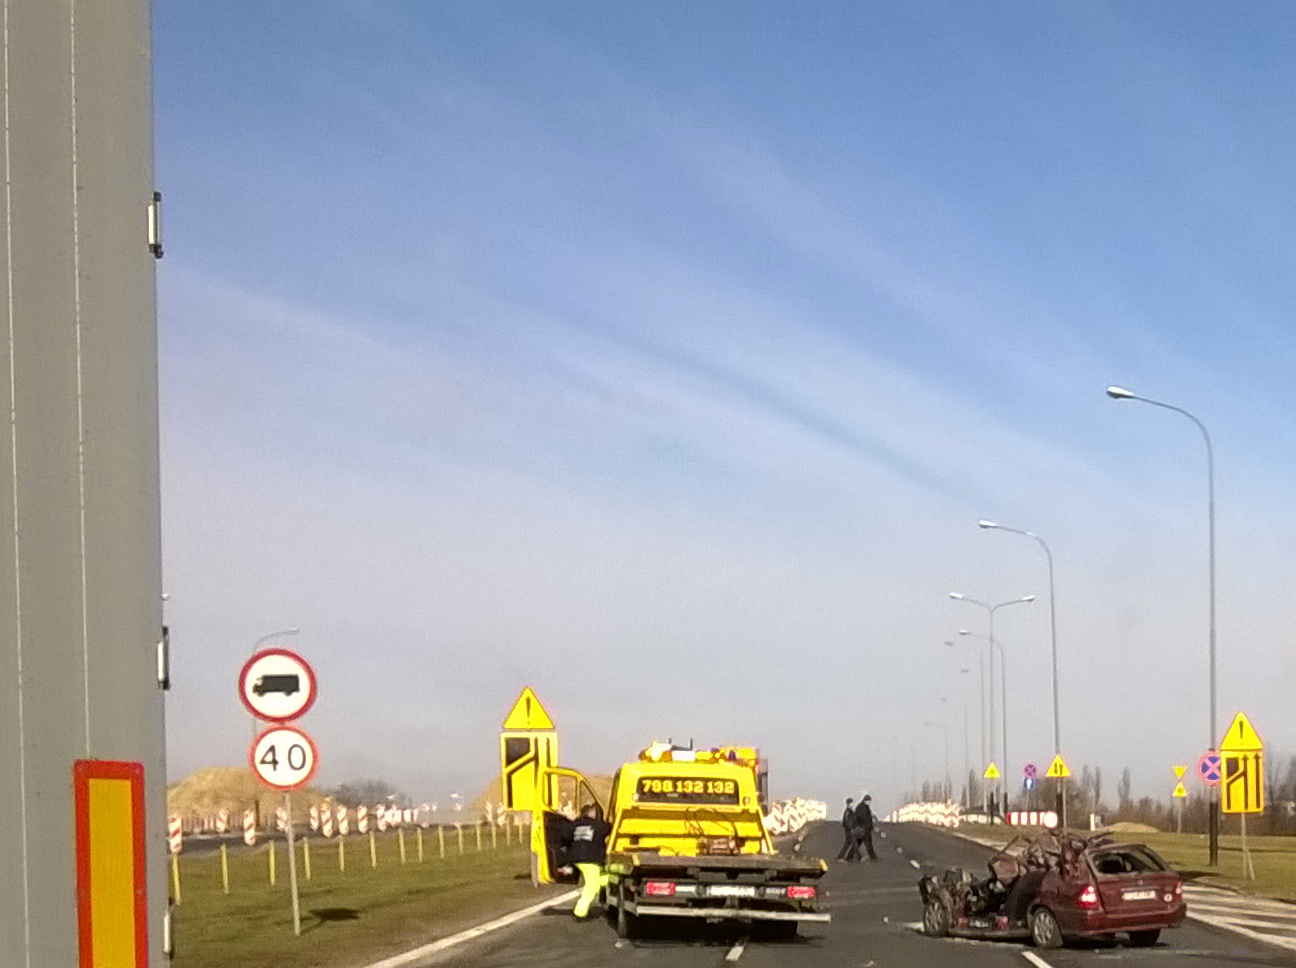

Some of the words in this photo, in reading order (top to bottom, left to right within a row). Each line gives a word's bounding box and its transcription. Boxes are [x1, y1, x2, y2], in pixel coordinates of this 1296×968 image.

[260, 743, 307, 772] 40
[675, 780, 704, 794] 132
[706, 781, 735, 795] 132
